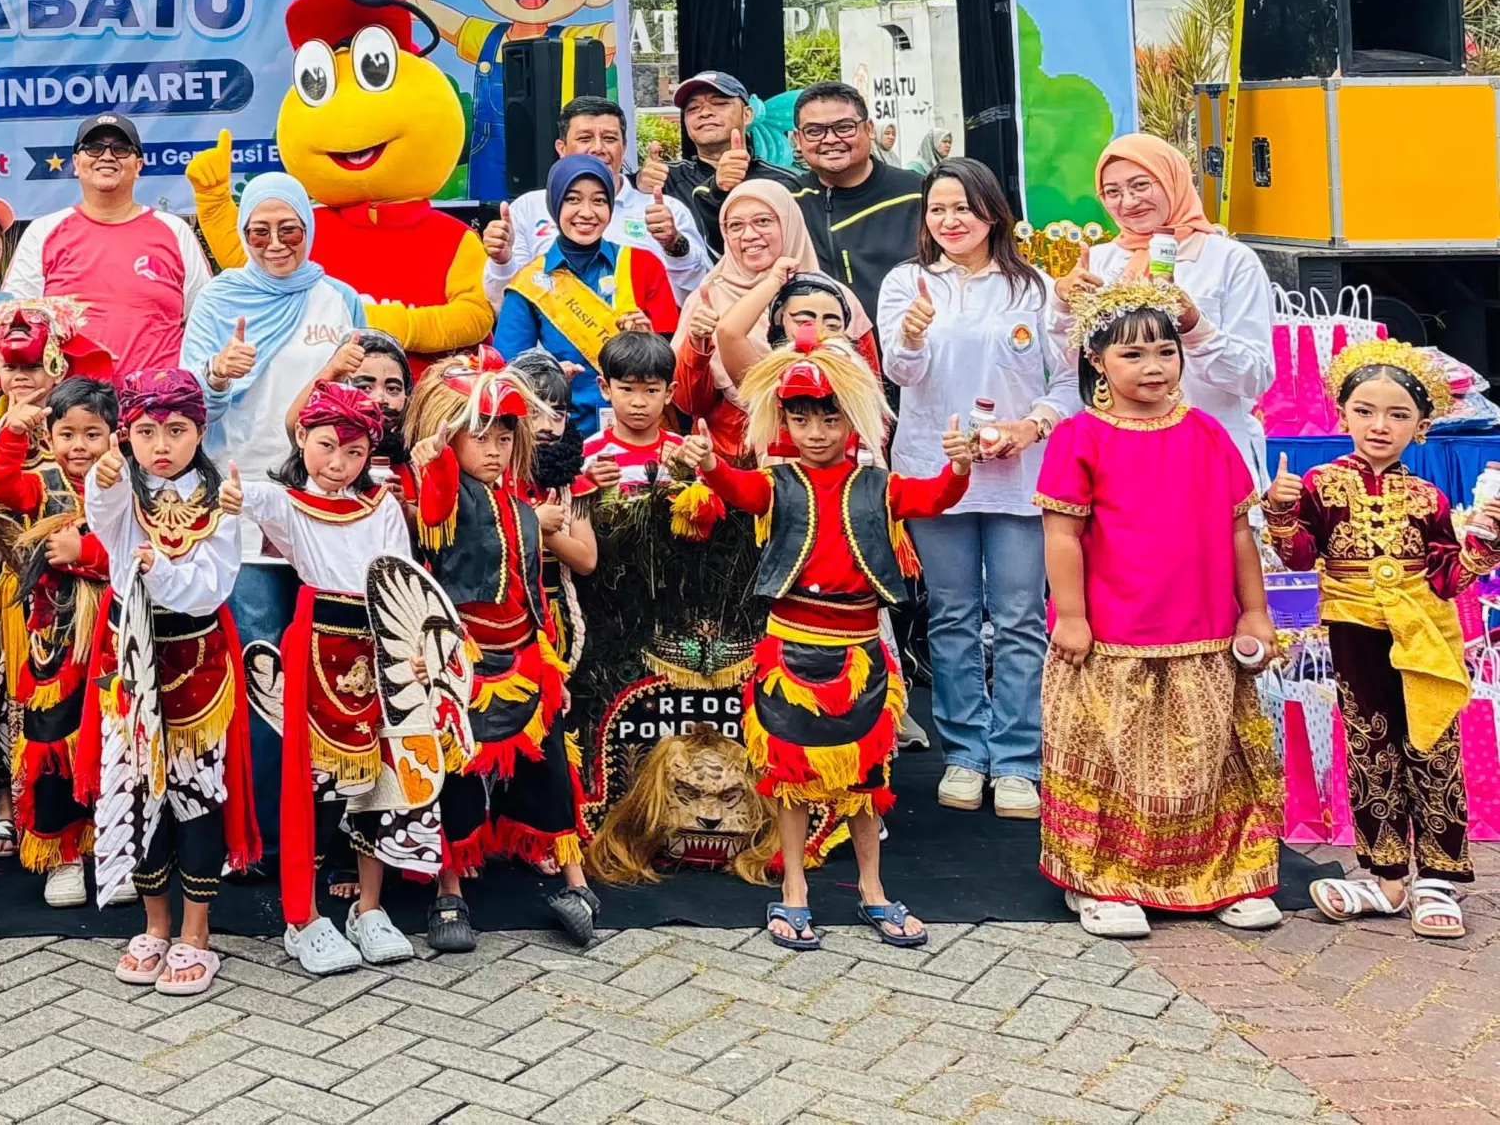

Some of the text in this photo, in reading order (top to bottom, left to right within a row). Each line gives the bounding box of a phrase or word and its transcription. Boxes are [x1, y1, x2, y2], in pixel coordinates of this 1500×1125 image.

[565, 298, 598, 330] Kasir
[658, 695, 742, 715] REOG
[619, 720, 739, 739] PONOO
